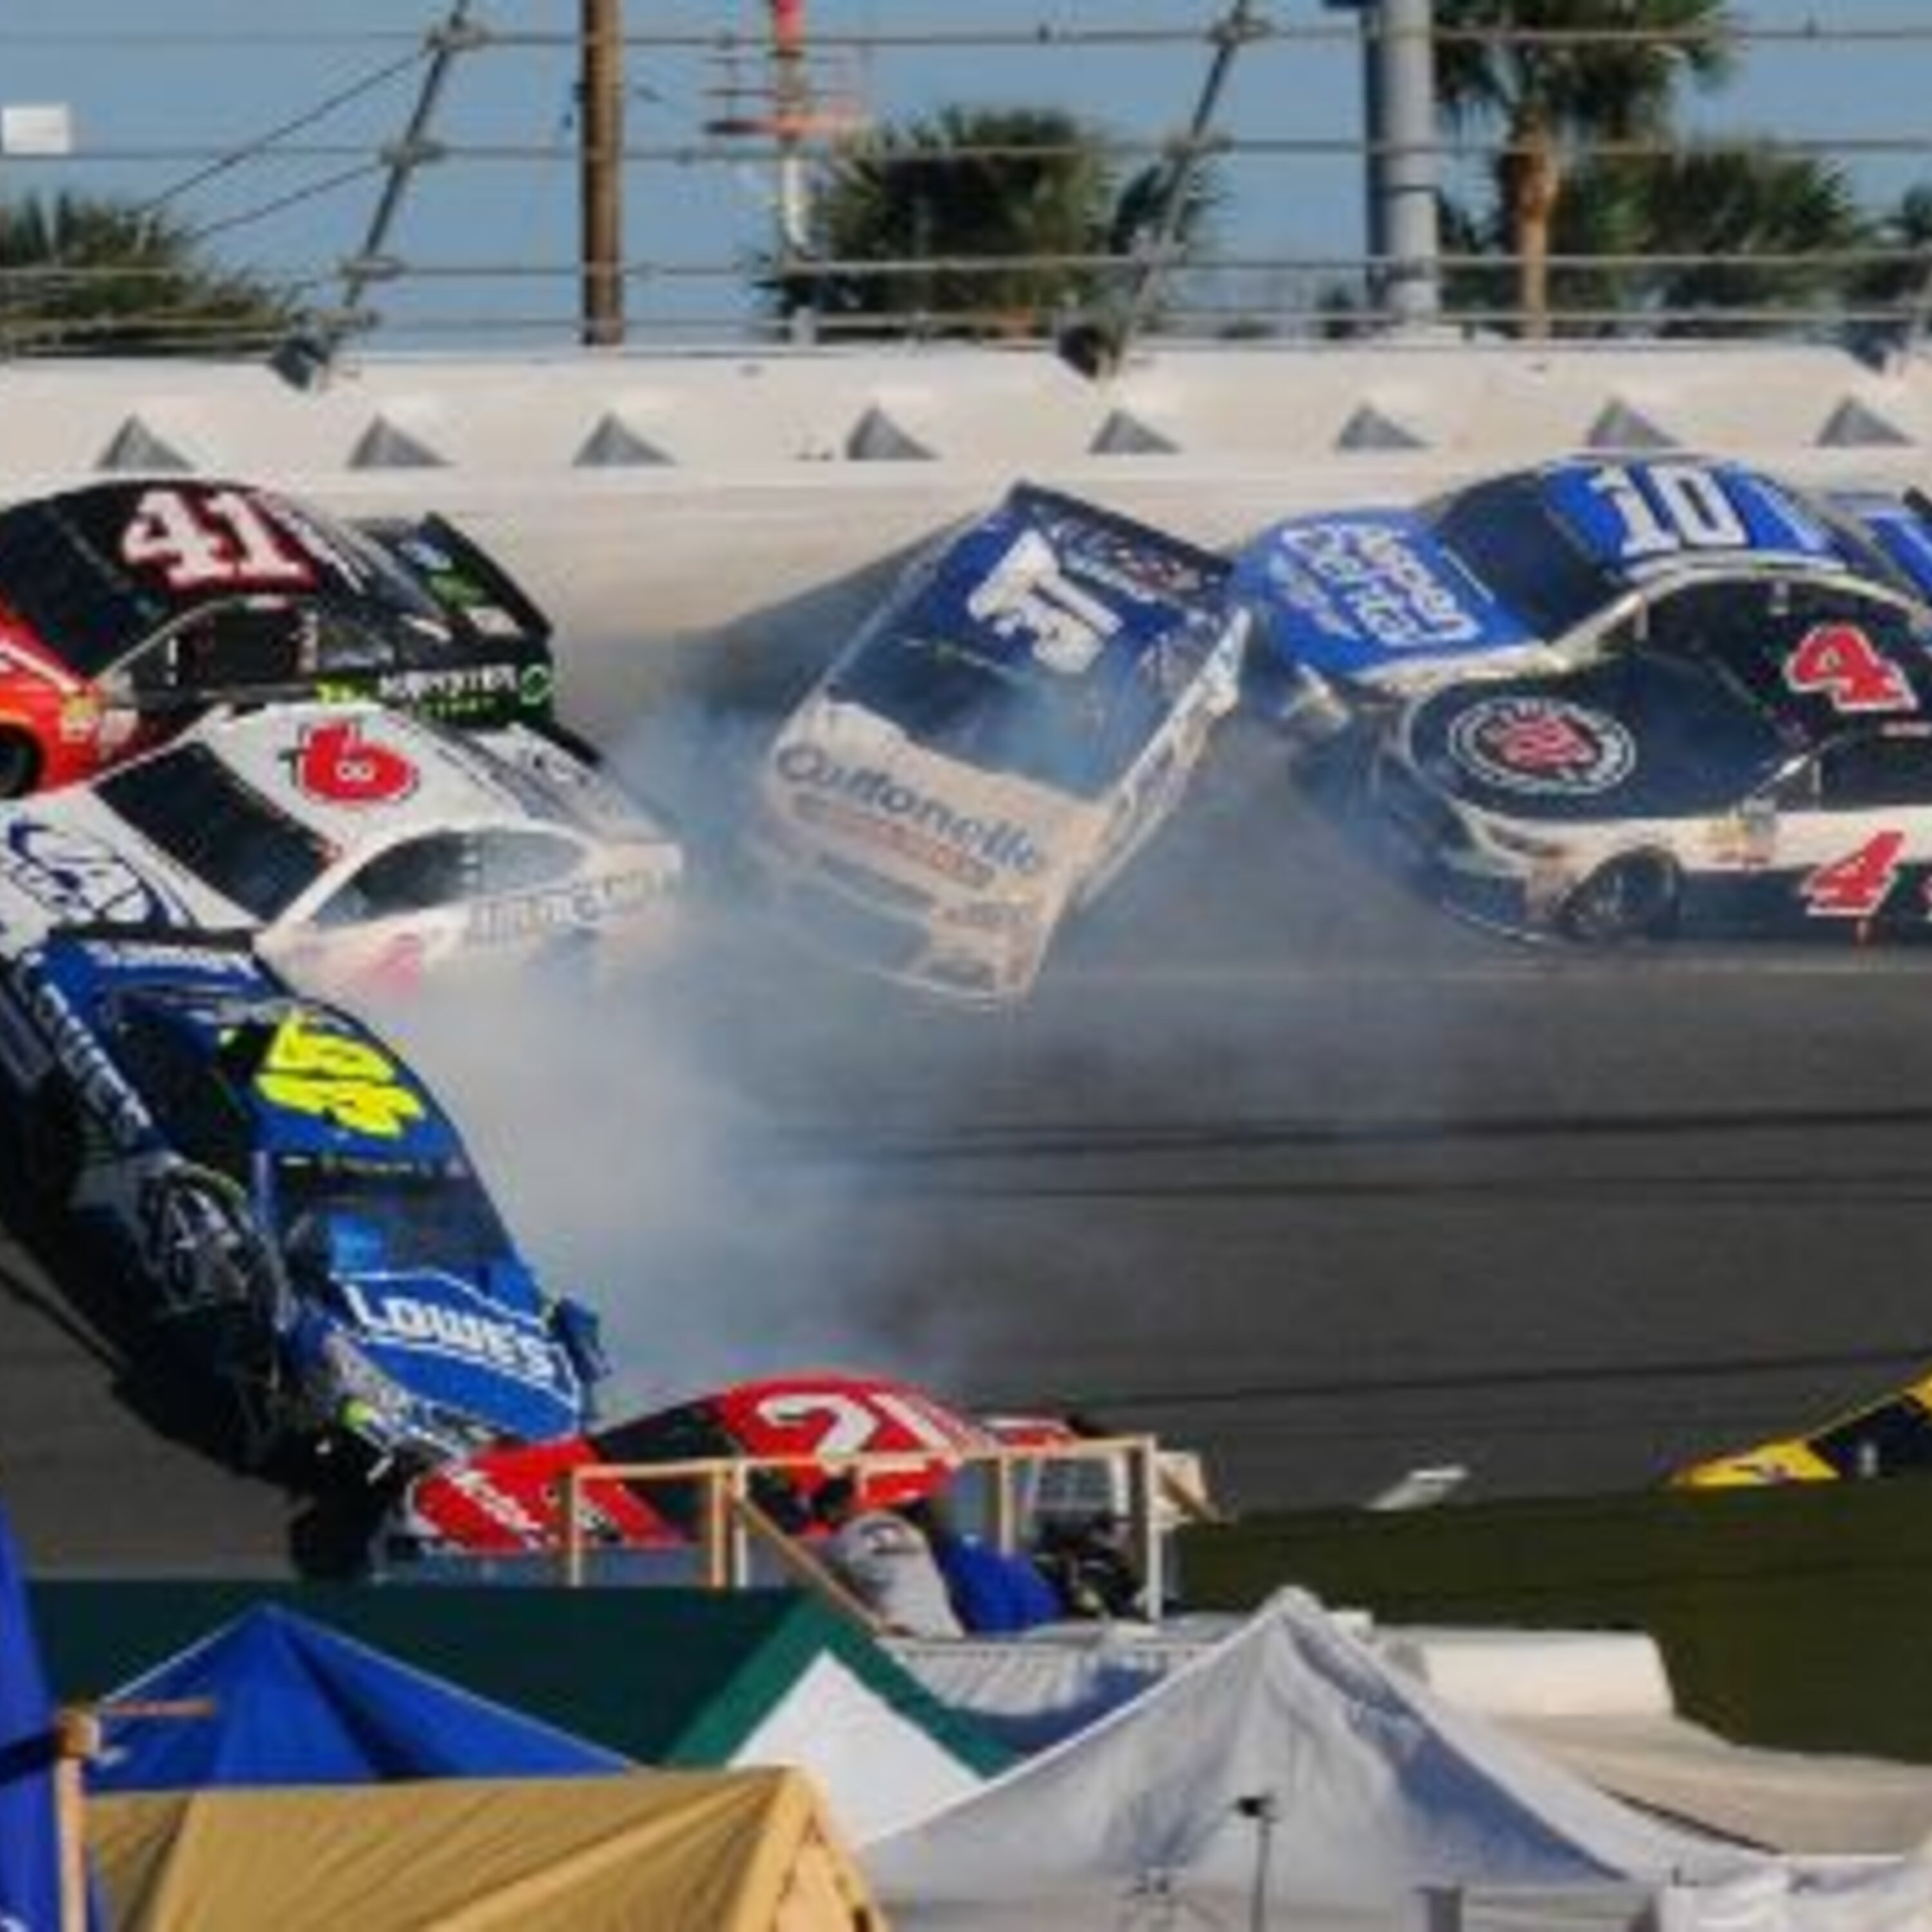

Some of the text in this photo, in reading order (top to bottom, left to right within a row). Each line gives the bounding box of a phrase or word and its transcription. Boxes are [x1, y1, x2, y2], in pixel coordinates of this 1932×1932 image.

[120, 488, 312, 589] 41
[1587, 465, 1749, 559] 10
[1784, 623, 1918, 712] 4
[294, 717, 421, 804] 6
[1801, 829, 1908, 916] 4
